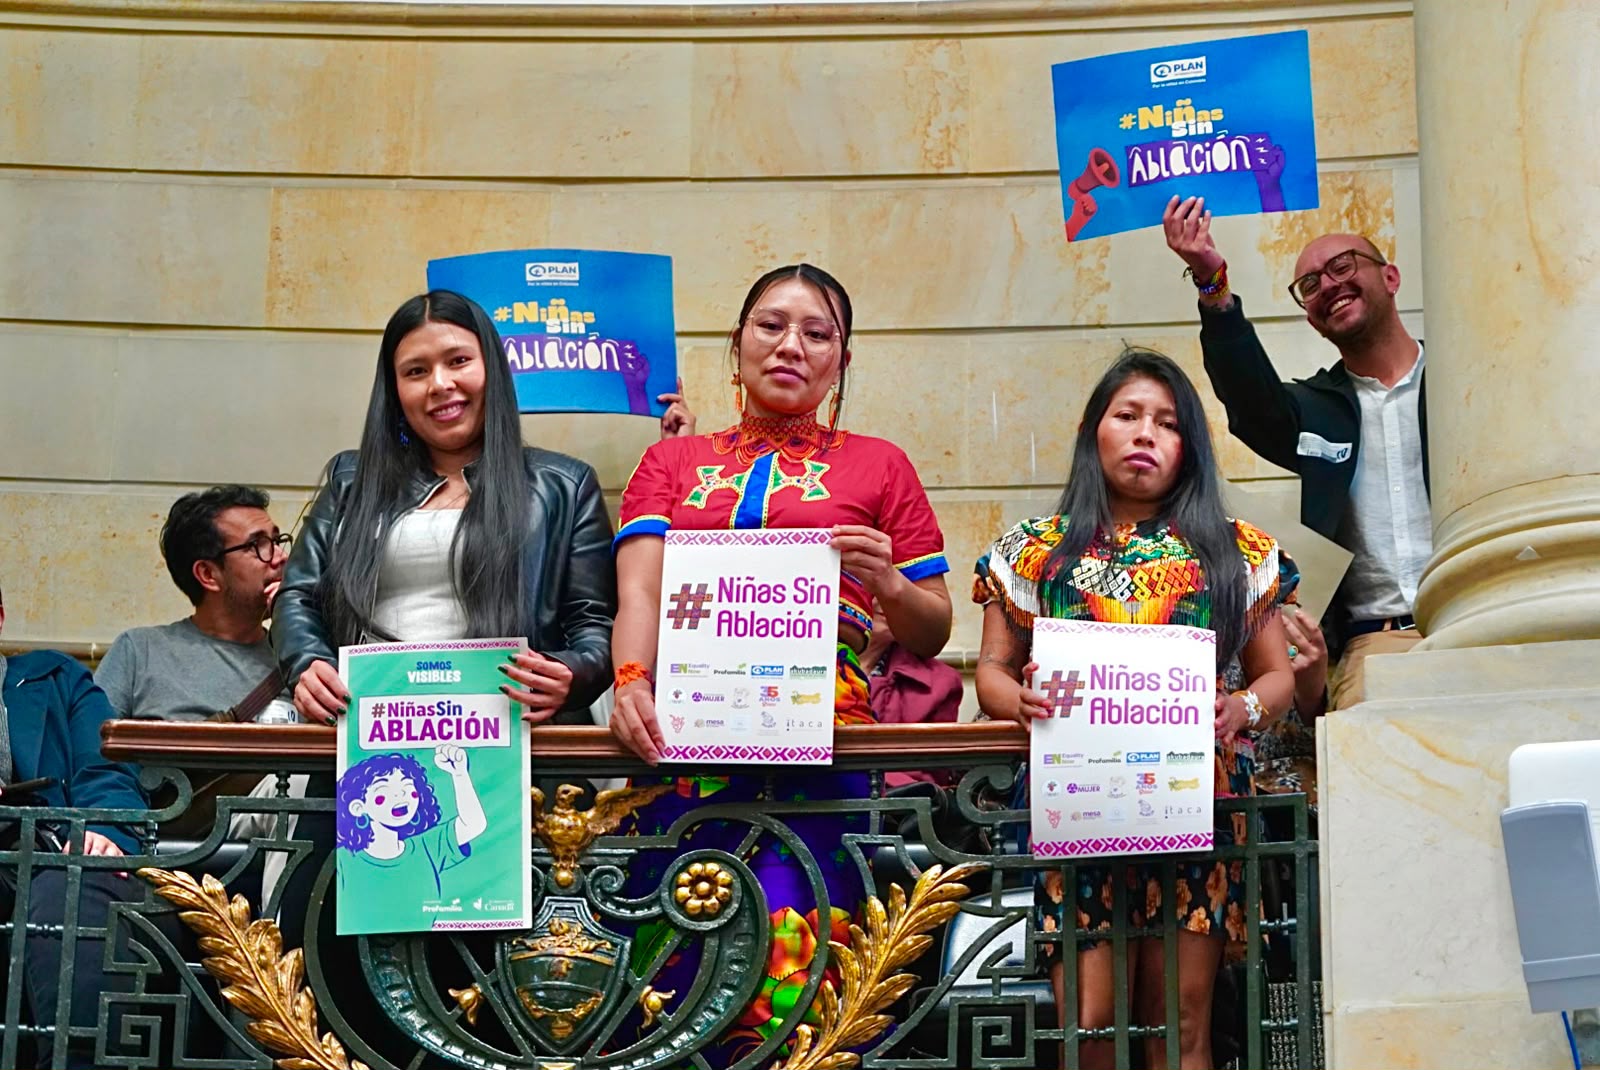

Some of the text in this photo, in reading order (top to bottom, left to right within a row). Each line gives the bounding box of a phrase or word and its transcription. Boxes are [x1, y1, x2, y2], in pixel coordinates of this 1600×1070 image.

[1173, 61, 1203, 72] PLAN
[1119, 98, 1224, 130] #Niñas
[548, 265, 577, 274] PLAN
[494, 298, 596, 323] #Niñas
[717, 576, 787, 604] Niñas
[793, 576, 831, 604] Sin
[716, 609, 823, 638] Ablación
[416, 661, 452, 670] SOMOS
[670, 663, 687, 674] EN
[407, 670, 462, 683] VISIBLES
[1090, 664, 1161, 691] Niñas
[1168, 667, 1207, 692] Sin
[371, 700, 462, 718] #NiñasSin
[1090, 697, 1199, 725] Ablación
[368, 711, 500, 743] ABLACIÓN
[1043, 753, 1061, 765] EN
[1140, 752, 1160, 760] PLAN
[1077, 785, 1101, 793] MUJER
